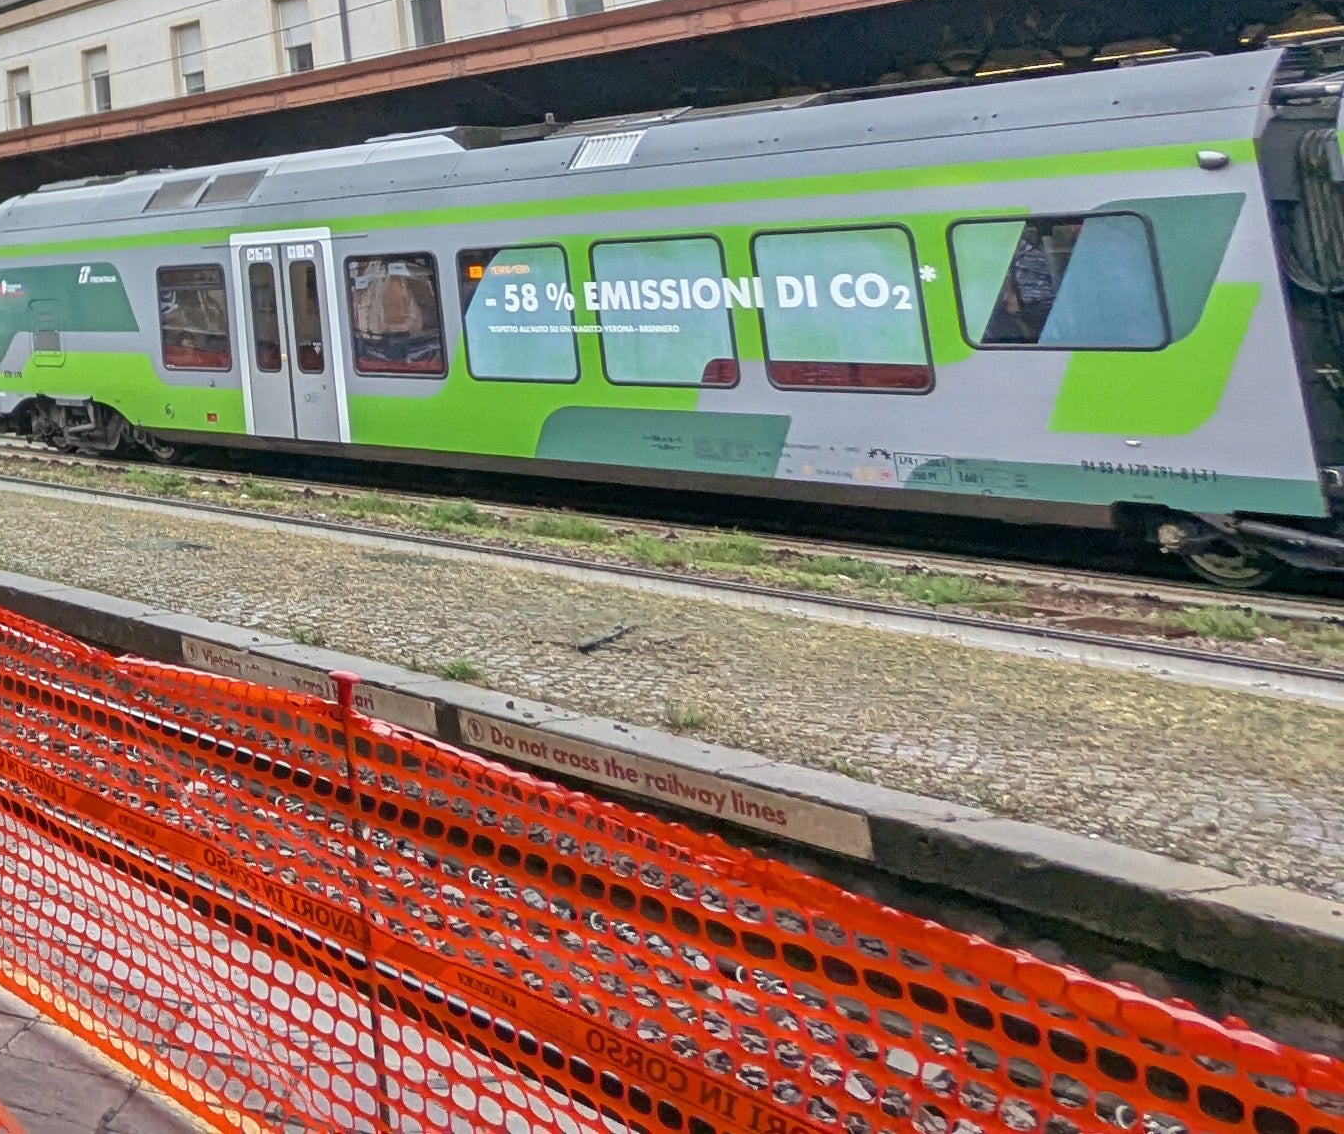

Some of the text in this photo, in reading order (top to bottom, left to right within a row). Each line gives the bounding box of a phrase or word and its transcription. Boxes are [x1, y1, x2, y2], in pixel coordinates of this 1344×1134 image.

[505, 282, 539, 312] 58
[545, 281, 576, 311] %
[583, 275, 765, 310] EMISSIONI
[776, 274, 818, 308] DI
[604, 325, 634, 333] VERONA
[640, 325, 680, 333] BRENNERO
[490, 724, 787, 826] Do not cross the railway lines
